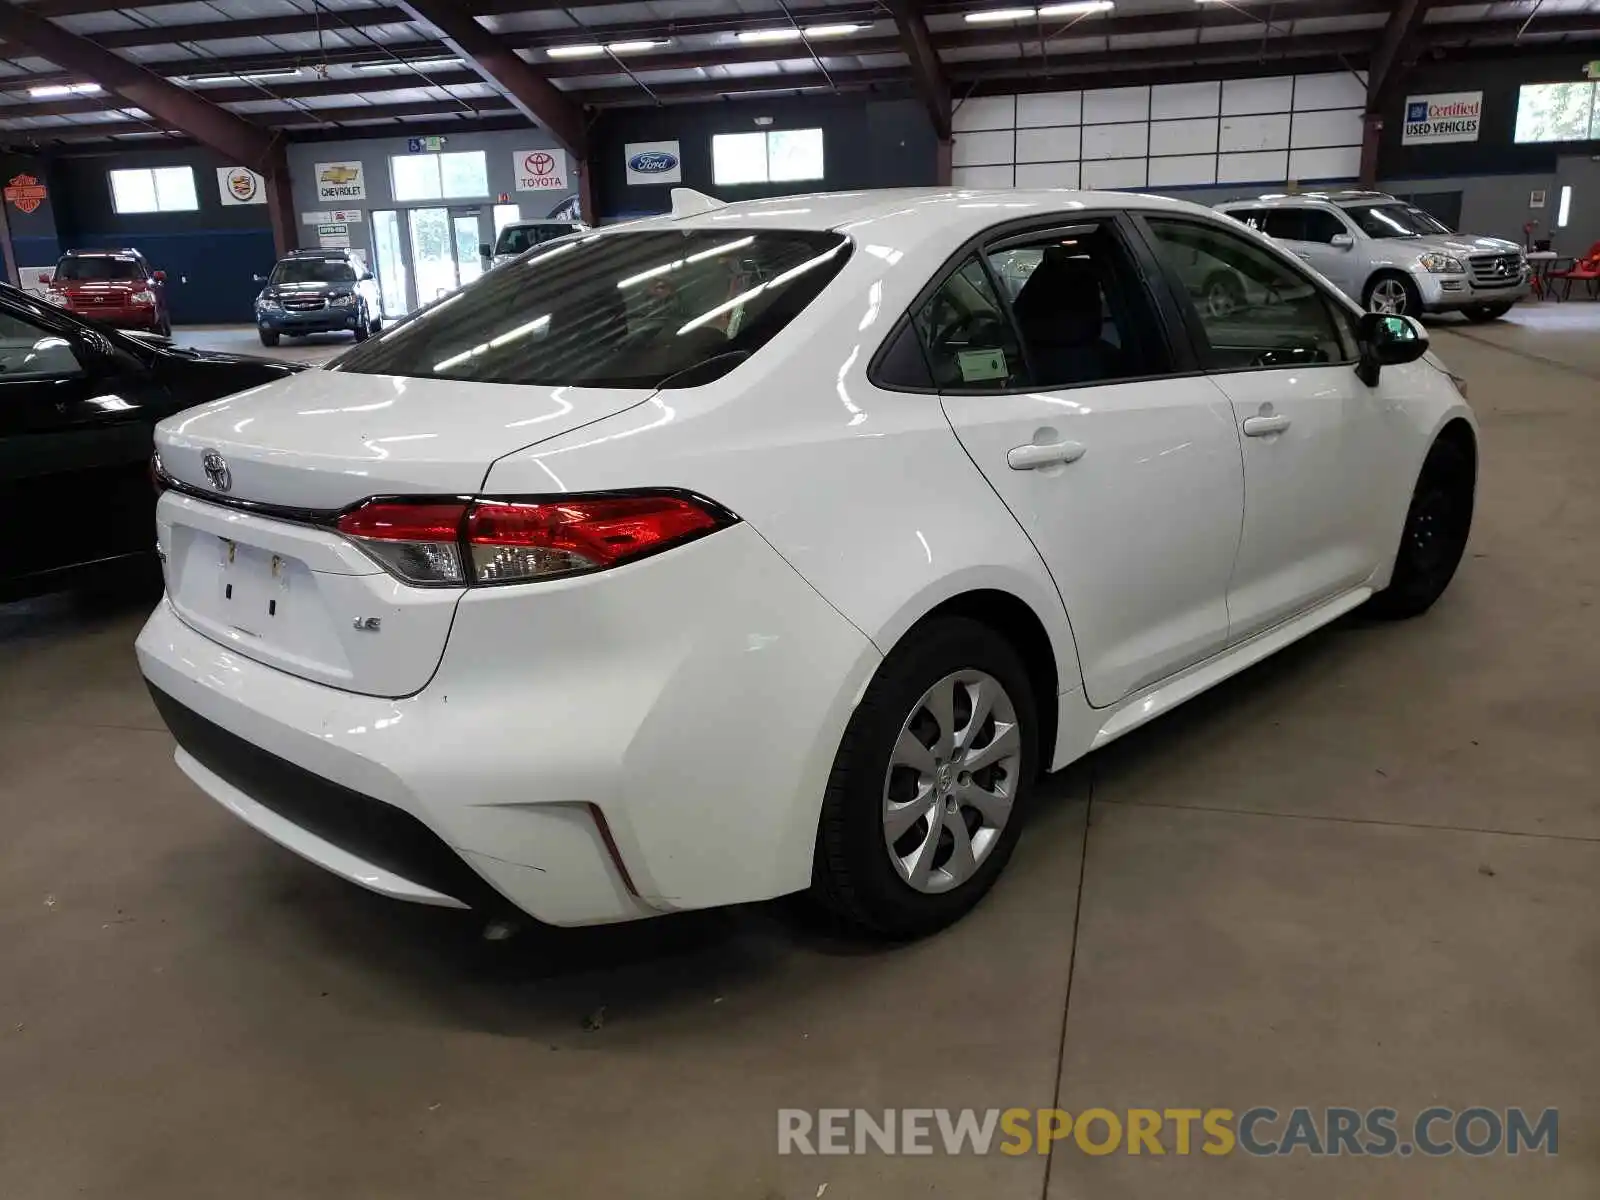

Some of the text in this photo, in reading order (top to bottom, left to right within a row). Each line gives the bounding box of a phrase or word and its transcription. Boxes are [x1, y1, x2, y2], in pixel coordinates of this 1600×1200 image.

[1429, 101, 1479, 117] Certified
[1406, 120, 1477, 135] USED VEHICLES
[638, 155, 668, 170] Ford
[520, 177, 562, 188] TOYOTA
[321, 186, 361, 197] CHEVROLET
